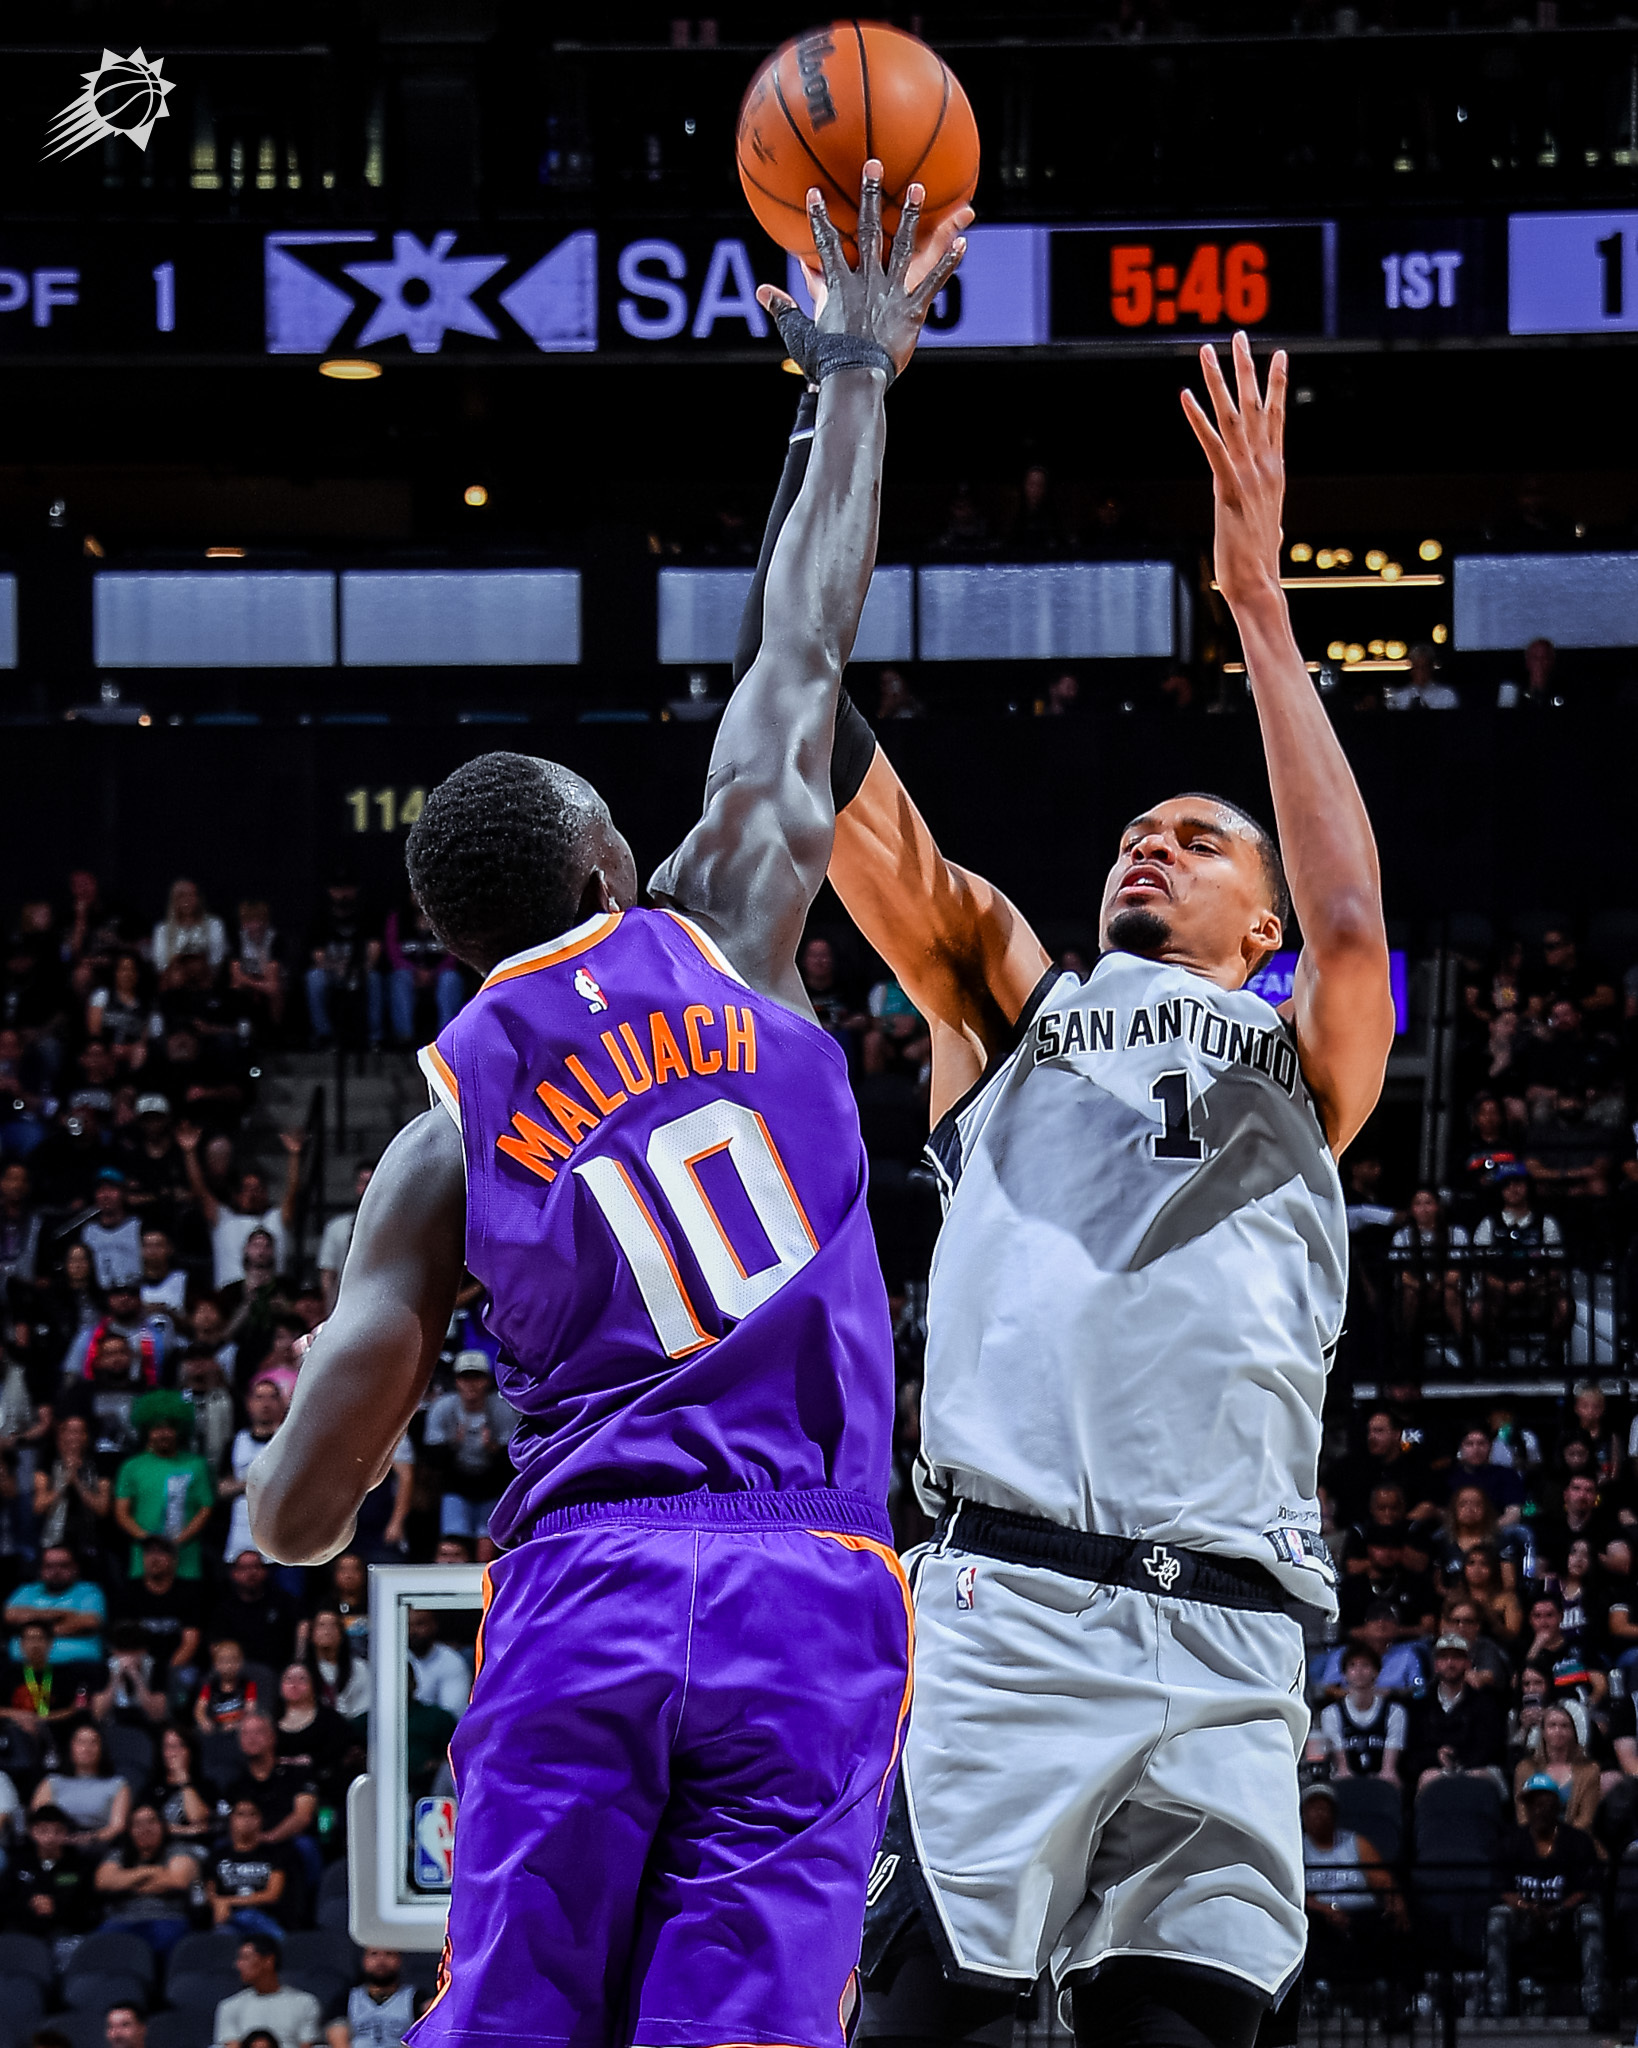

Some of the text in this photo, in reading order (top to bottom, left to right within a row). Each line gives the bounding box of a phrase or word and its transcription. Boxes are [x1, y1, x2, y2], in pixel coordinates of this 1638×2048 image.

[152, 260, 175, 332] 1
[617, 238, 769, 340] SA
[1110, 242, 1270, 327] 5:46
[1382, 250, 1462, 309] 1ST
[1595, 230, 1638, 318] 1
[347, 788, 425, 832] 114
[1034, 996, 1299, 1100] SAN ANTONIO
[496, 1005, 757, 1183] MALUACH
[1148, 1069, 1206, 1162] 1
[572, 1099, 820, 1359] 10
